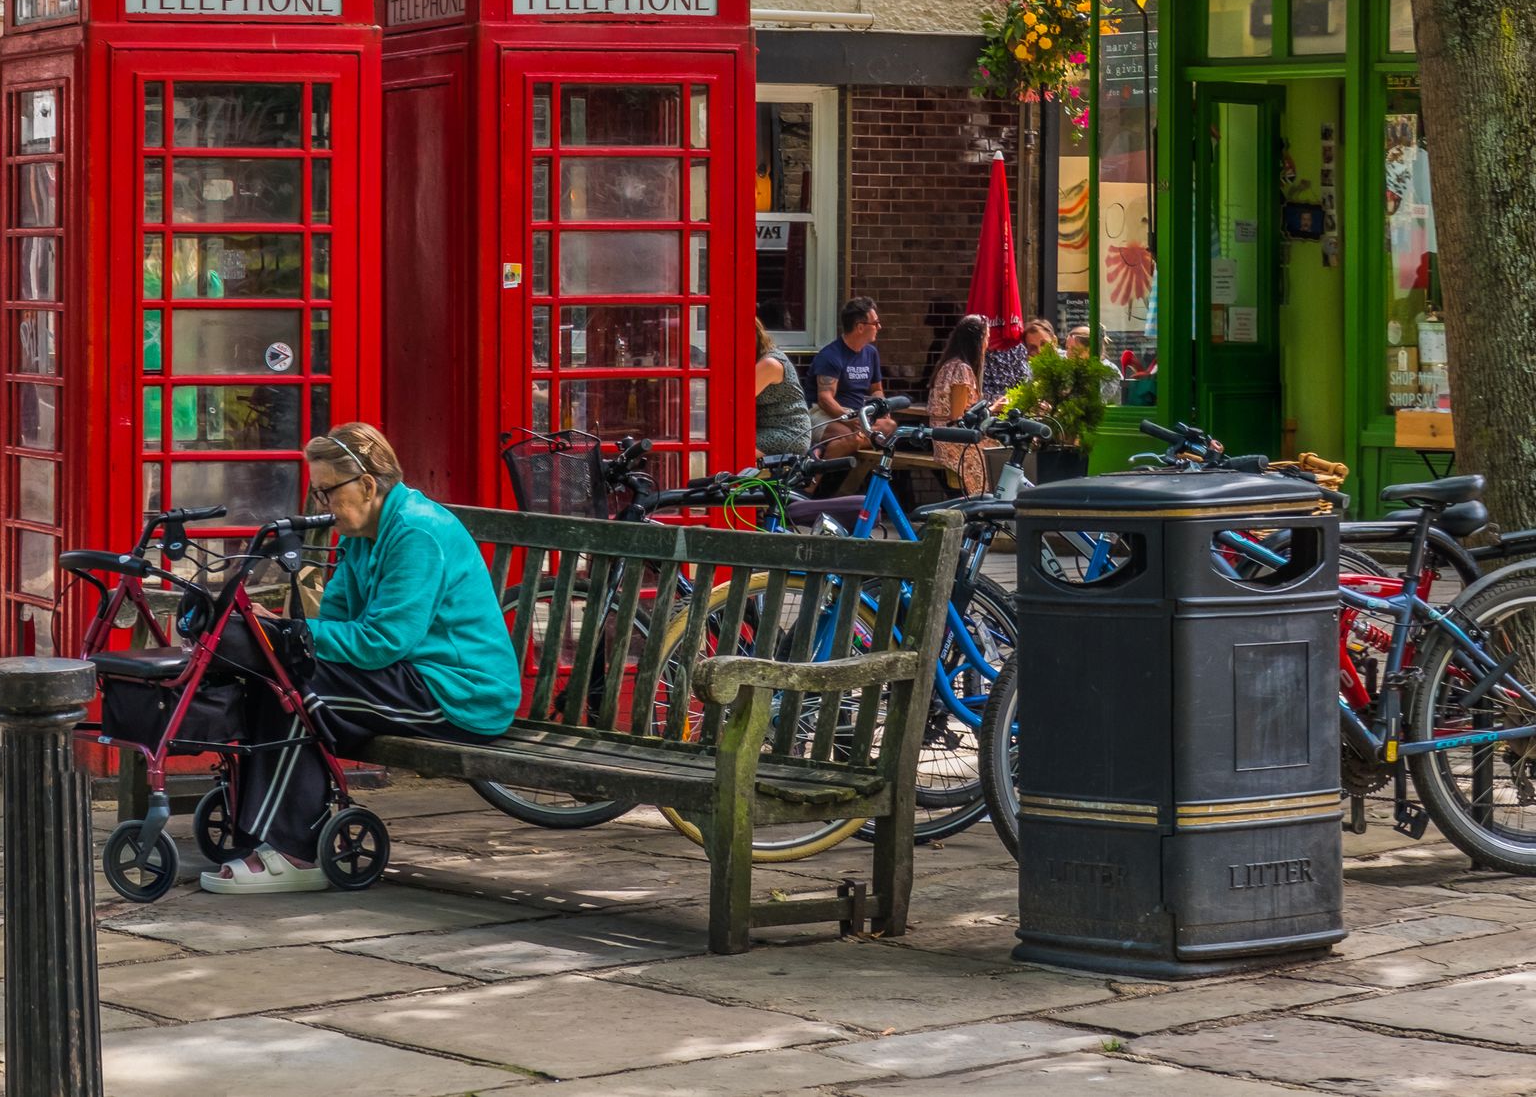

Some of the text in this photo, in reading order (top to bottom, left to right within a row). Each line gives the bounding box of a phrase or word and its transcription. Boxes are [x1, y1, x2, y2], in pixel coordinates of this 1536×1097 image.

[1105, 42, 1137, 53] mary's
[1115, 63, 1143, 76] givin
[1389, 371, 1415, 385] SHOP
[1389, 393, 1415, 407] SHOP
[1228, 857, 1315, 890] LITTER
